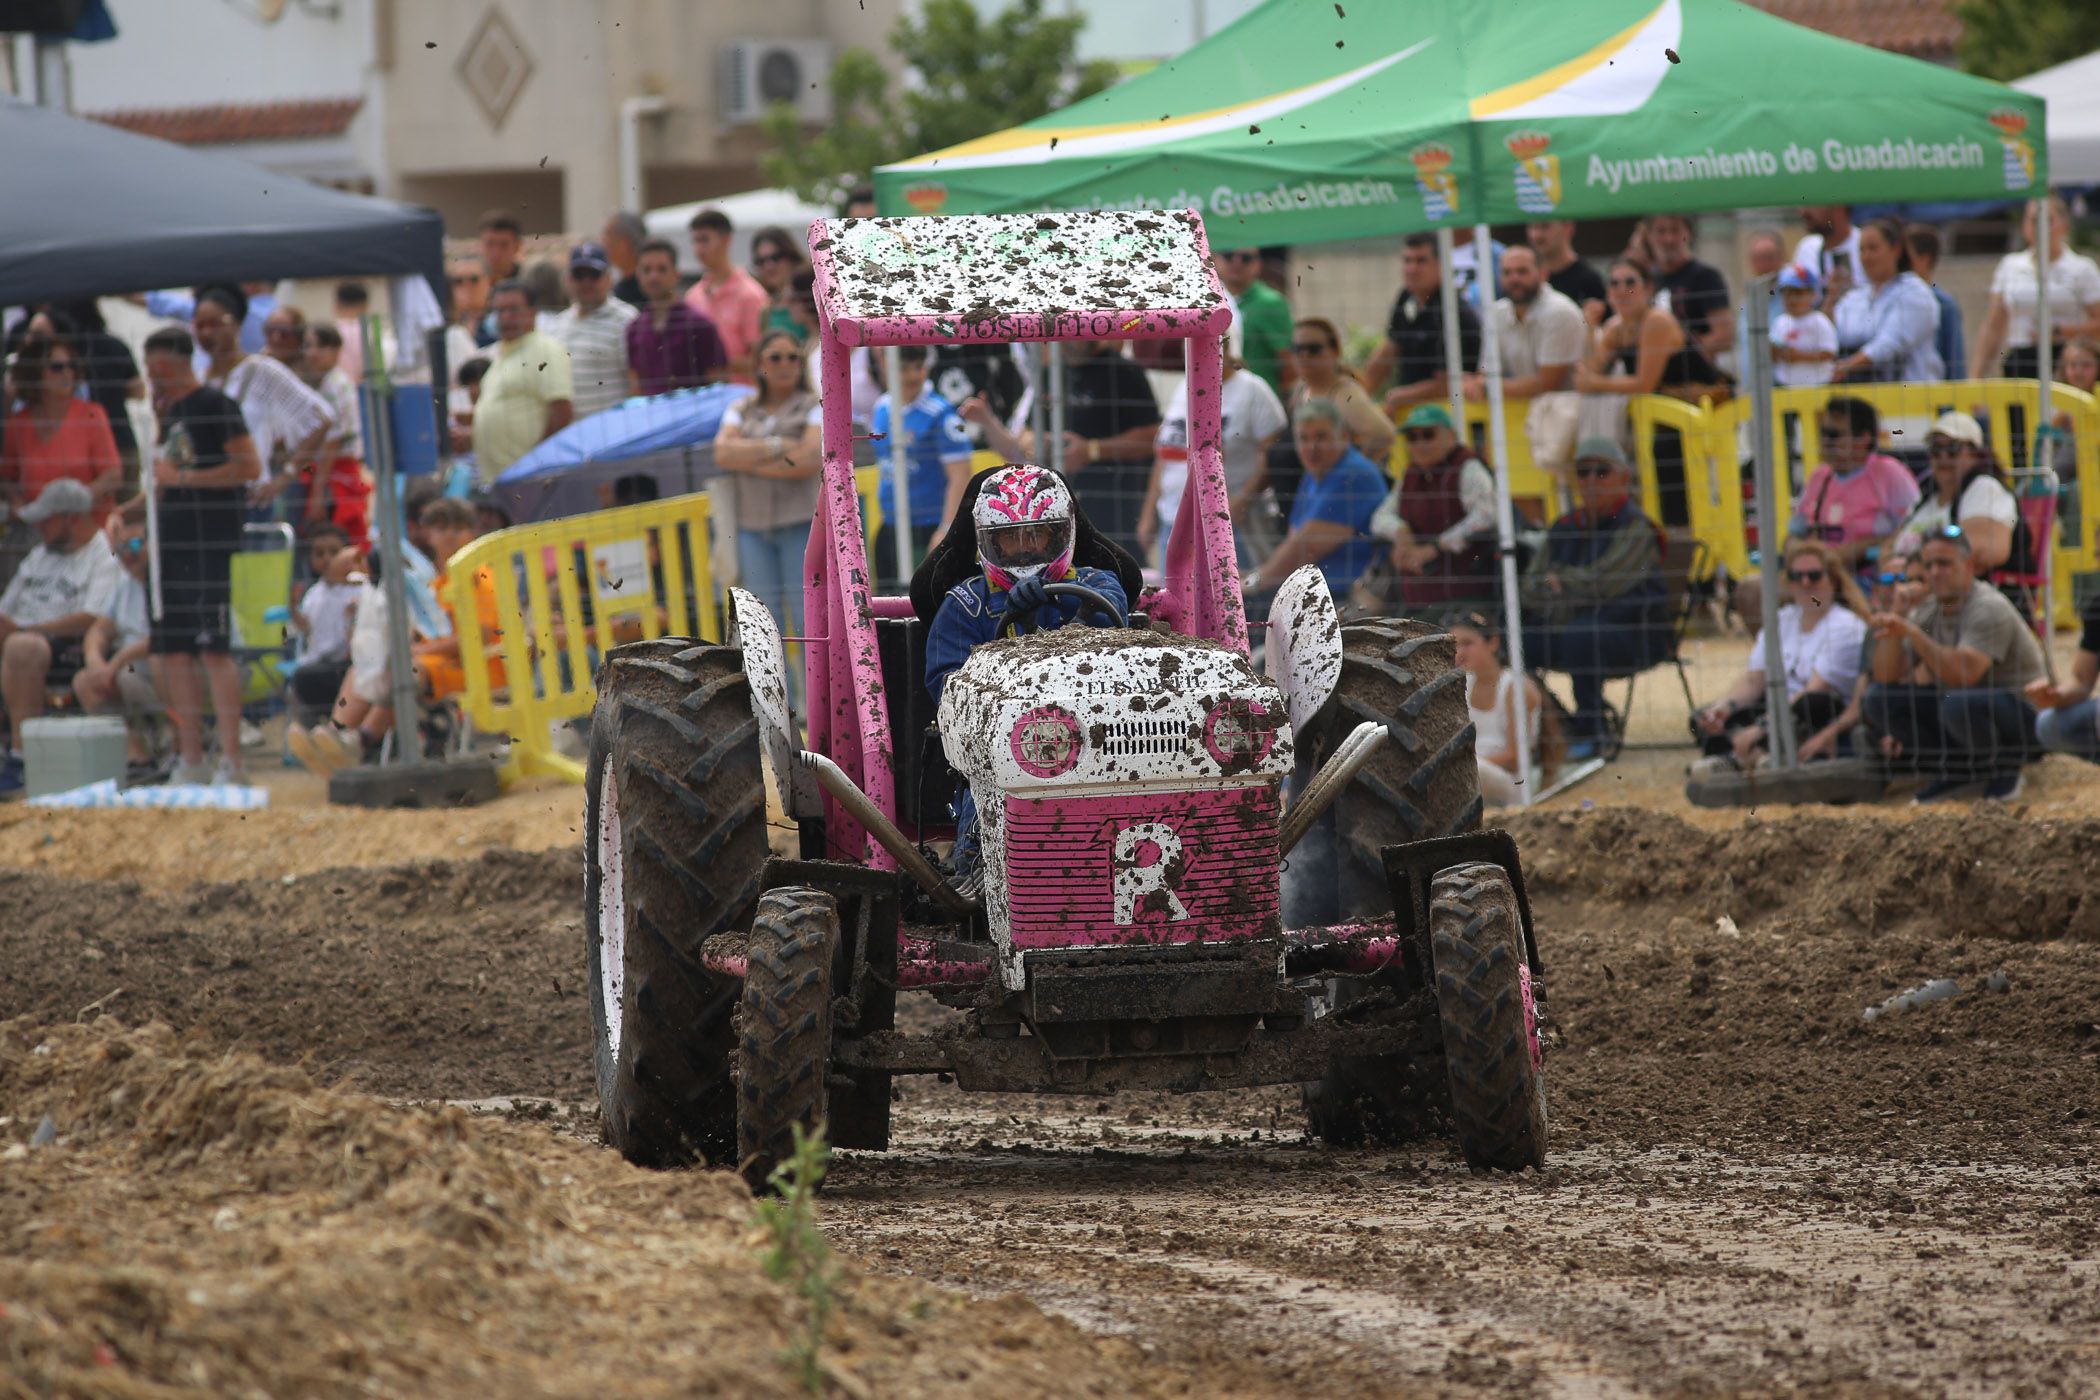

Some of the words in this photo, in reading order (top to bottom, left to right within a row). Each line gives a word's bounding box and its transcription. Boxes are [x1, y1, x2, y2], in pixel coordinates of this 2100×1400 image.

[1586, 146, 1778, 194] Ayuntamiento
[1783, 142, 1818, 174] de
[1086, 675, 1201, 695] ELISABTH
[1113, 822, 1190, 926] R
